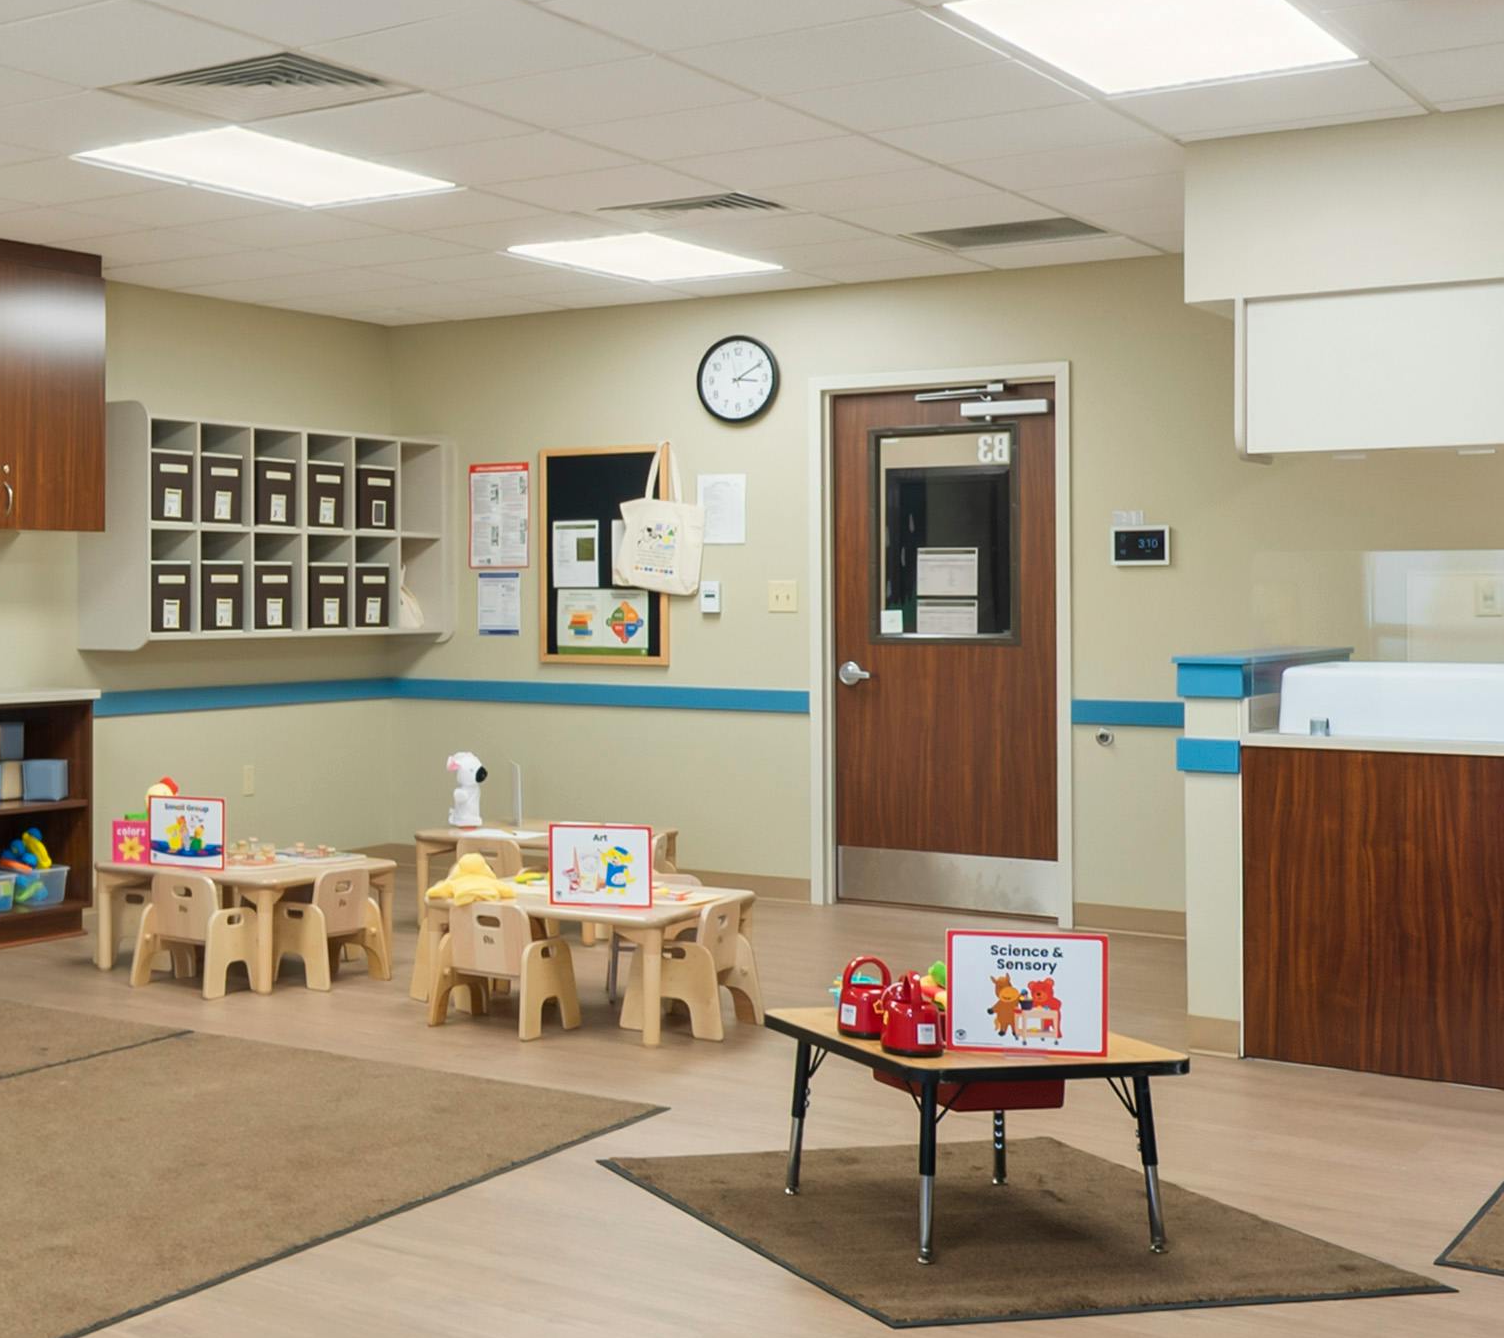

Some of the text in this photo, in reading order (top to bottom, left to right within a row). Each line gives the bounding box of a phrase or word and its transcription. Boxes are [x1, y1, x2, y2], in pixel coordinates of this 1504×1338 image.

[721, 352, 730, 360] 11
[733, 347, 743, 356] 12
[713, 362, 722, 371] 10
[708, 376, 714, 385] 9
[762, 373, 768, 382] 3
[713, 390, 719, 399] 8
[748, 398, 754, 407] 5
[735, 403, 741, 412] 6
[164, 803, 209, 813] Small Group
[116, 827, 146, 837] colors
[593, 834, 608, 842] Art
[990, 944, 1064, 958] Science &
[996, 959, 1058, 975] Sensory
